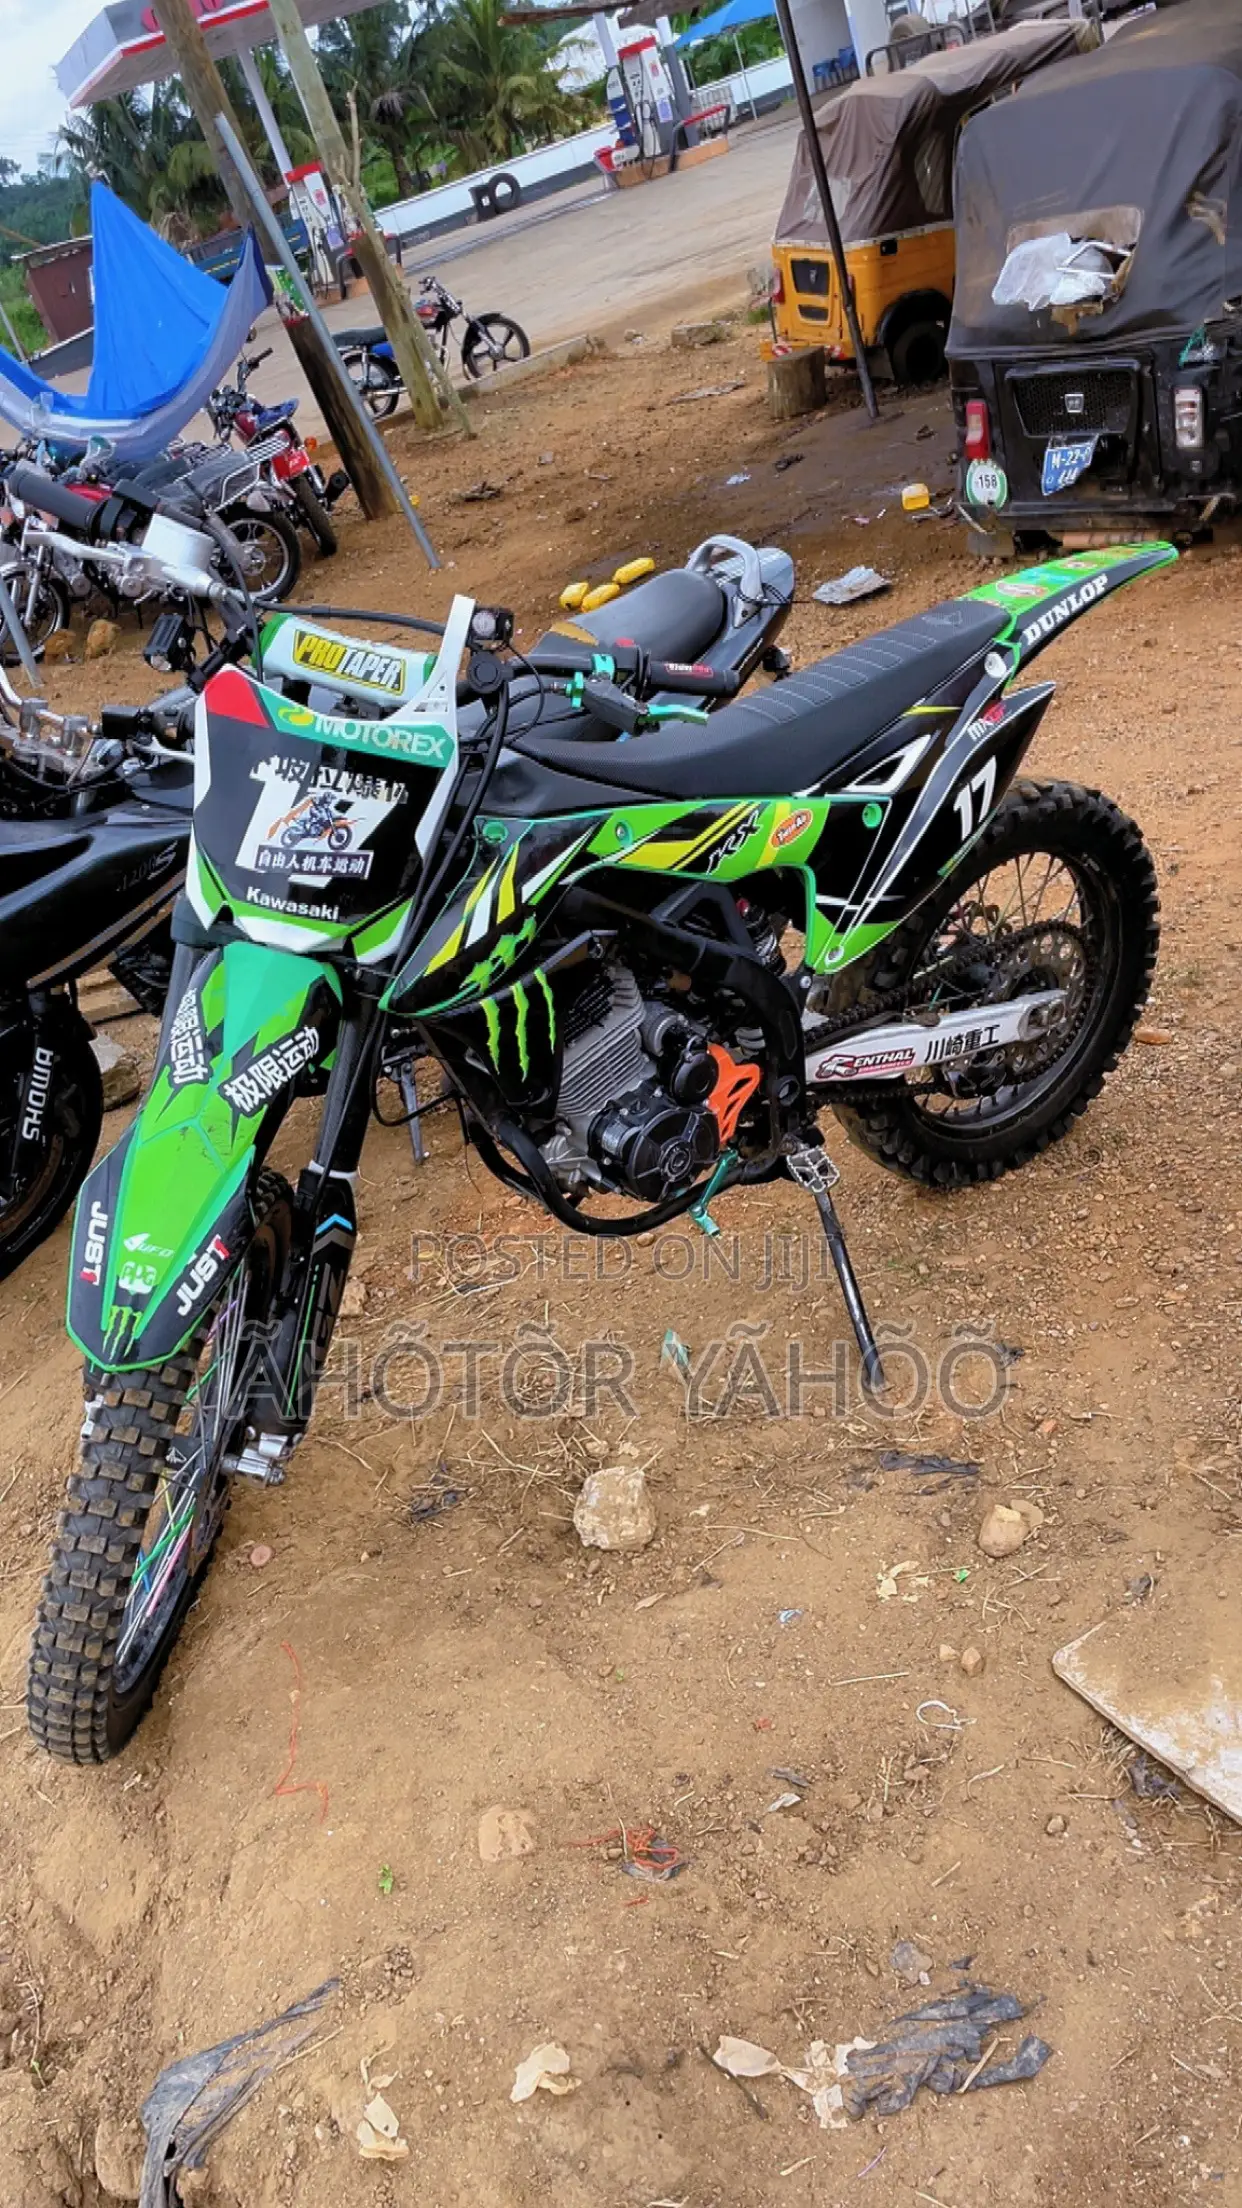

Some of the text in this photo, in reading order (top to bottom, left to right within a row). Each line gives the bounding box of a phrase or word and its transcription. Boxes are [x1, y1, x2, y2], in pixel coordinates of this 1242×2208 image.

[978, 474, 998, 490] 158
[1022, 573, 1109, 646] DUNLOP
[314, 714, 447, 761] MOTOREX
[953, 755, 997, 841] 17
[245, 886, 340, 921] Kawasaki
[223, 1025, 321, 1113] 极限运动
[924, 1024, 1001, 1063] 川崎重工
[22, 1046, 54, 1140] SHOWA
[80, 1201, 108, 1286] JUST
[177, 1234, 231, 1317] JUST
